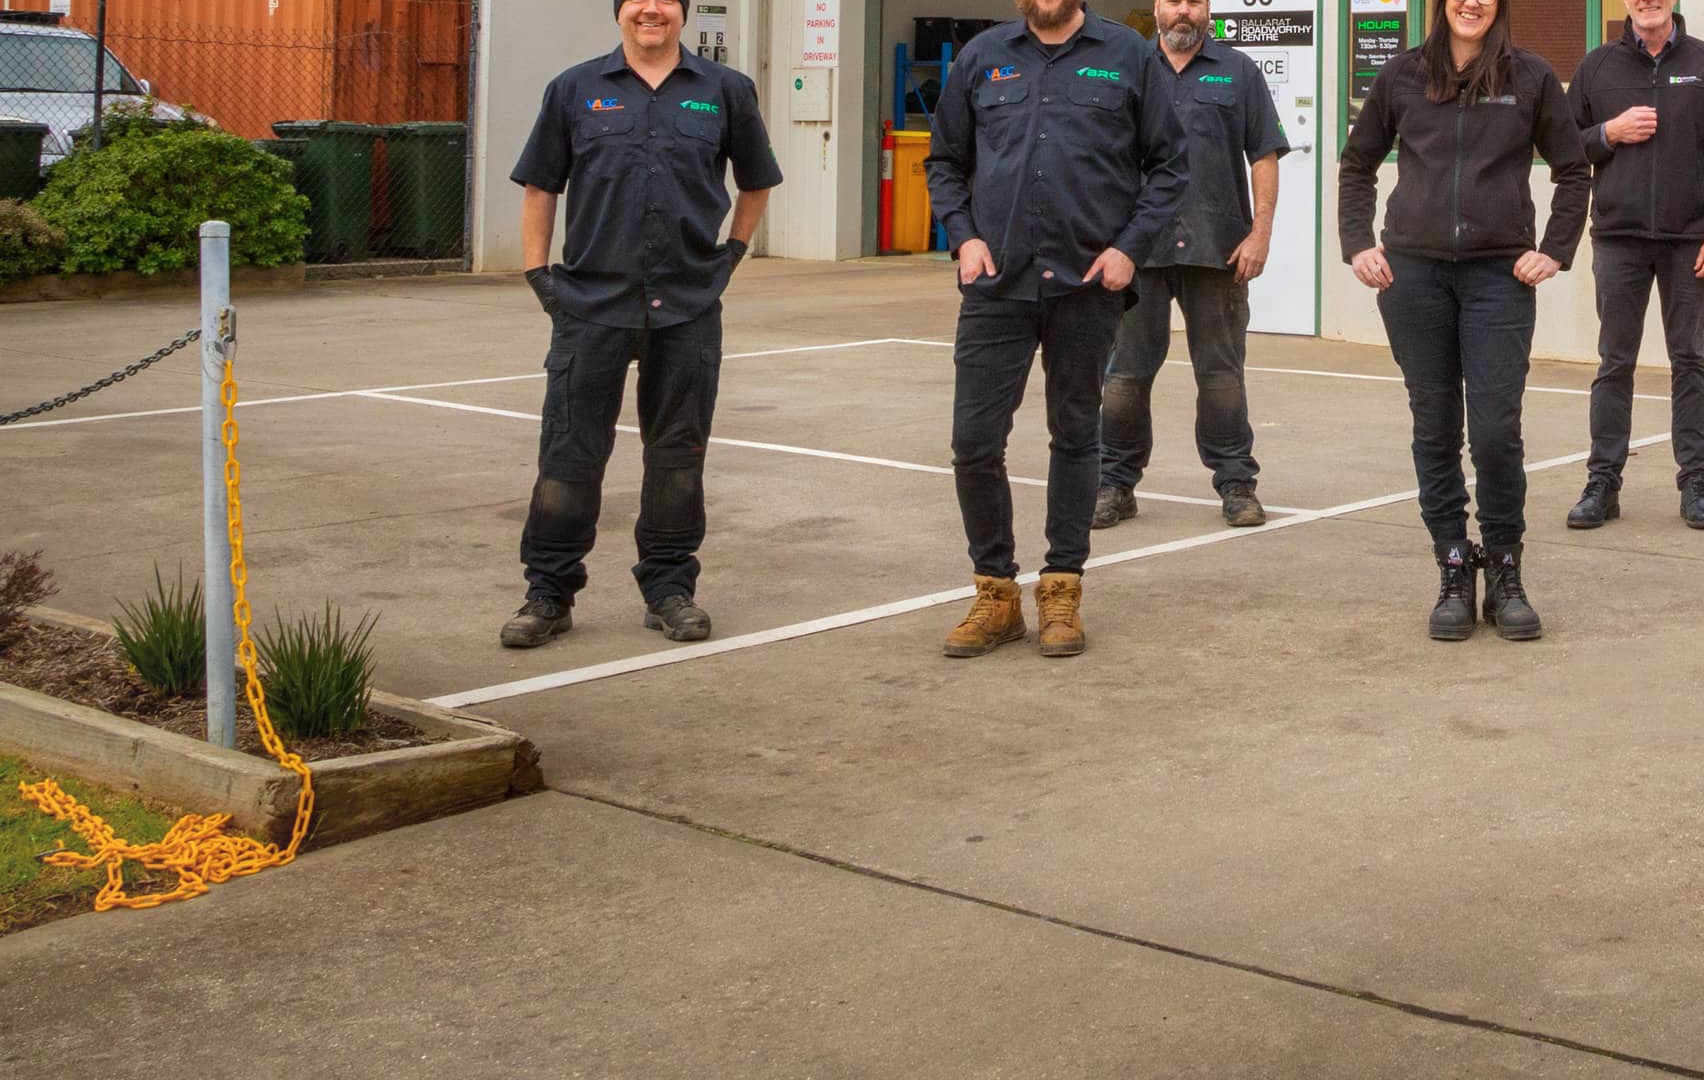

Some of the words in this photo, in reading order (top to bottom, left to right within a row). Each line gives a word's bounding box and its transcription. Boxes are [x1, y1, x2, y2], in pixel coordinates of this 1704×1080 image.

[816, 3, 826, 11] NO
[806, 20, 835, 28] PARKING
[1241, 18, 1292, 27] BALLARAT
[1358, 21, 1400, 30] HOURS
[1241, 25, 1313, 35] ROADWORTHY
[817, 36, 824, 44] IN
[1241, 32, 1280, 41] CENTRE
[803, 52, 836, 61] DRIVEWAY
[1087, 69, 1120, 81] BRC
[1206, 75, 1233, 84] BRC
[690, 102, 721, 114] BRC
